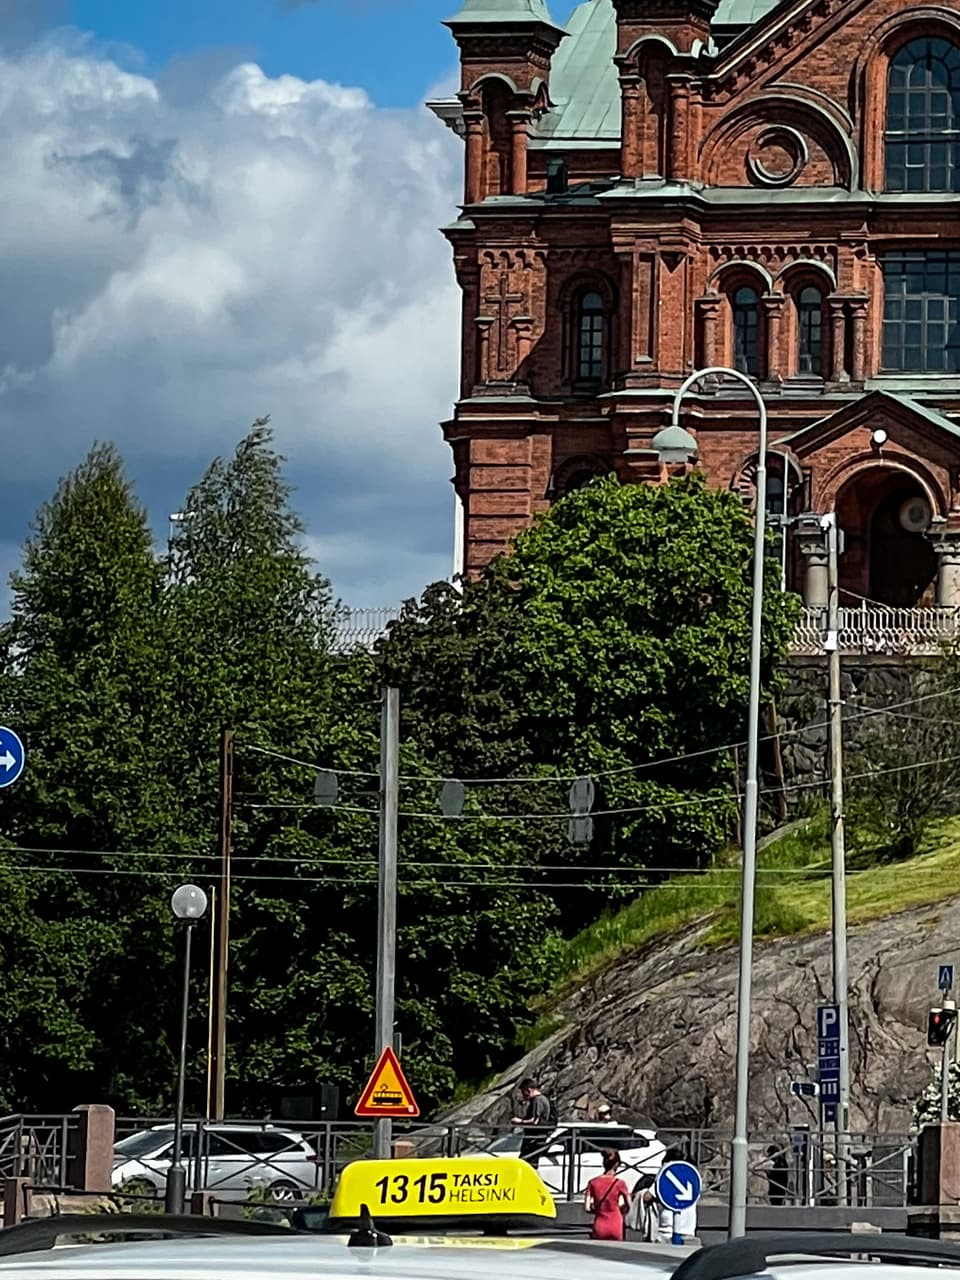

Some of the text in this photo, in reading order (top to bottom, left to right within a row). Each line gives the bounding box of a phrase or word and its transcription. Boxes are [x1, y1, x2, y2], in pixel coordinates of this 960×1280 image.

[822, 1008, 837, 1037] P
[376, 1173, 448, 1204] 1315
[452, 1173, 499, 1187] TAKSI
[449, 1188, 516, 1203] HELSINKI
